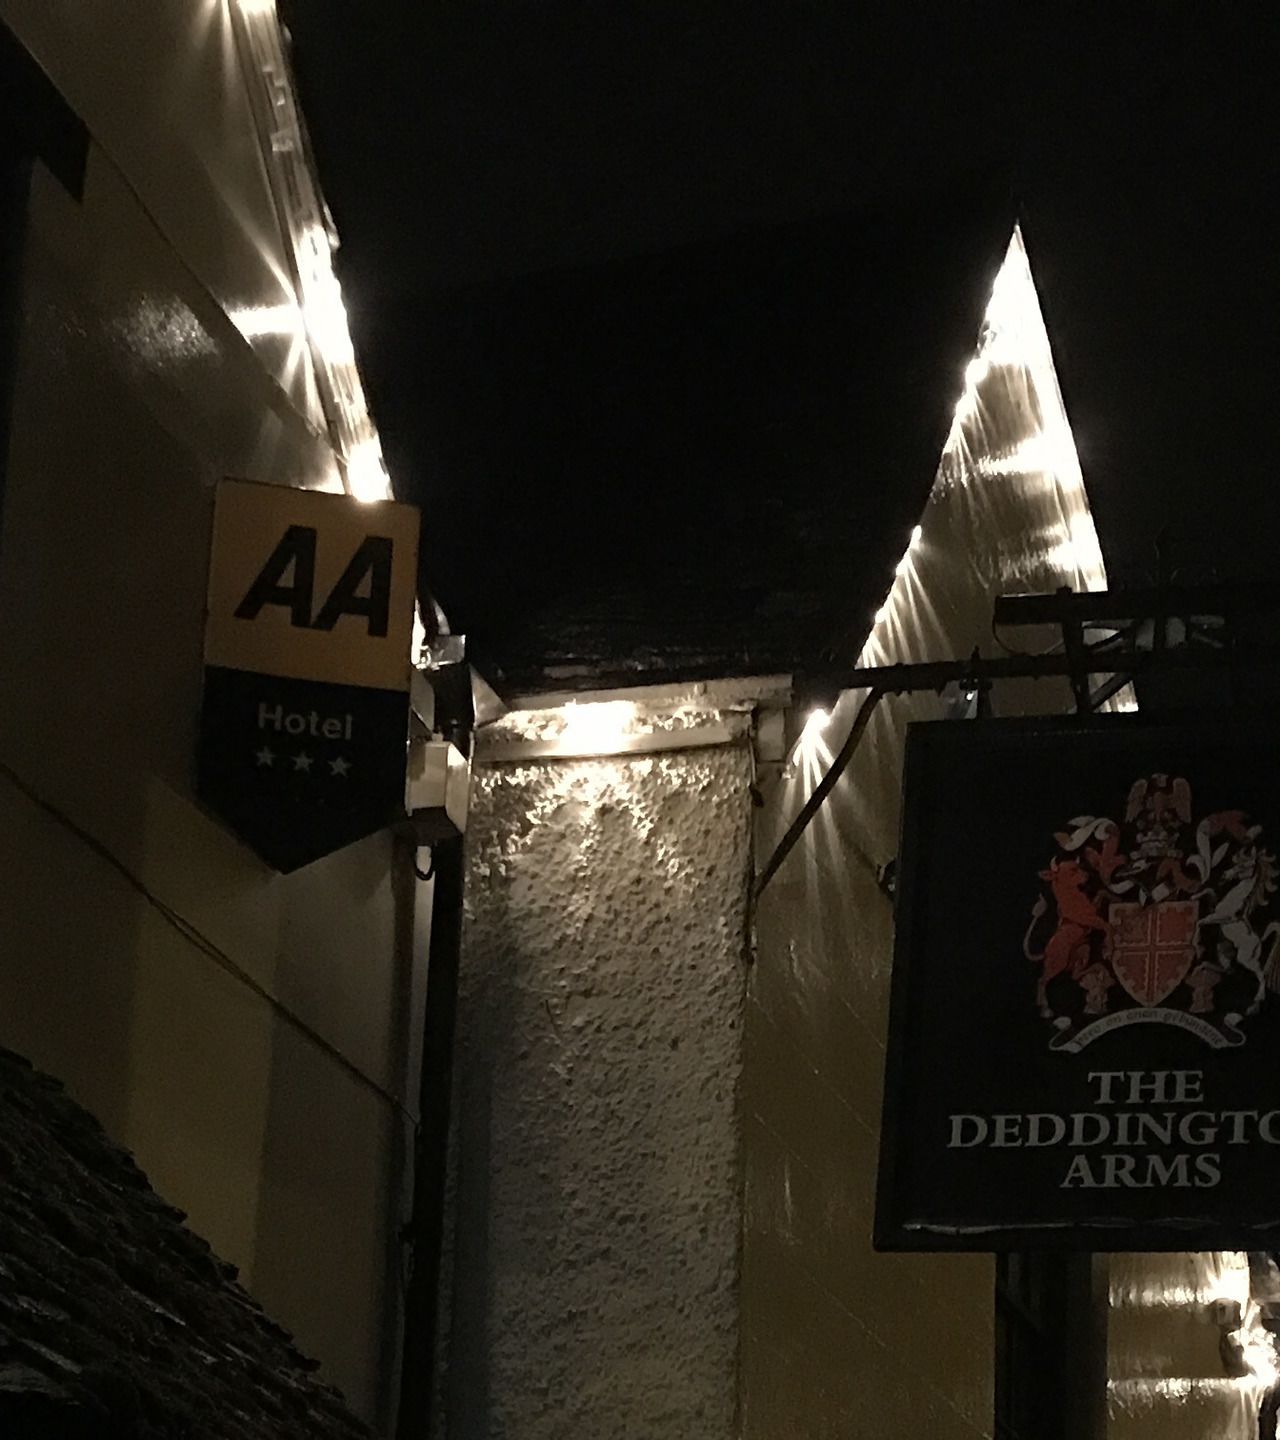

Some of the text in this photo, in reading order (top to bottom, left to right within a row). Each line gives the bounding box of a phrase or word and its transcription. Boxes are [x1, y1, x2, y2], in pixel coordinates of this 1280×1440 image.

[233, 524, 393, 638] AA
[256, 701, 353, 741] Hotel
[1087, 1069, 1205, 1105] THE
[1059, 1152, 1222, 1189] ARMS
